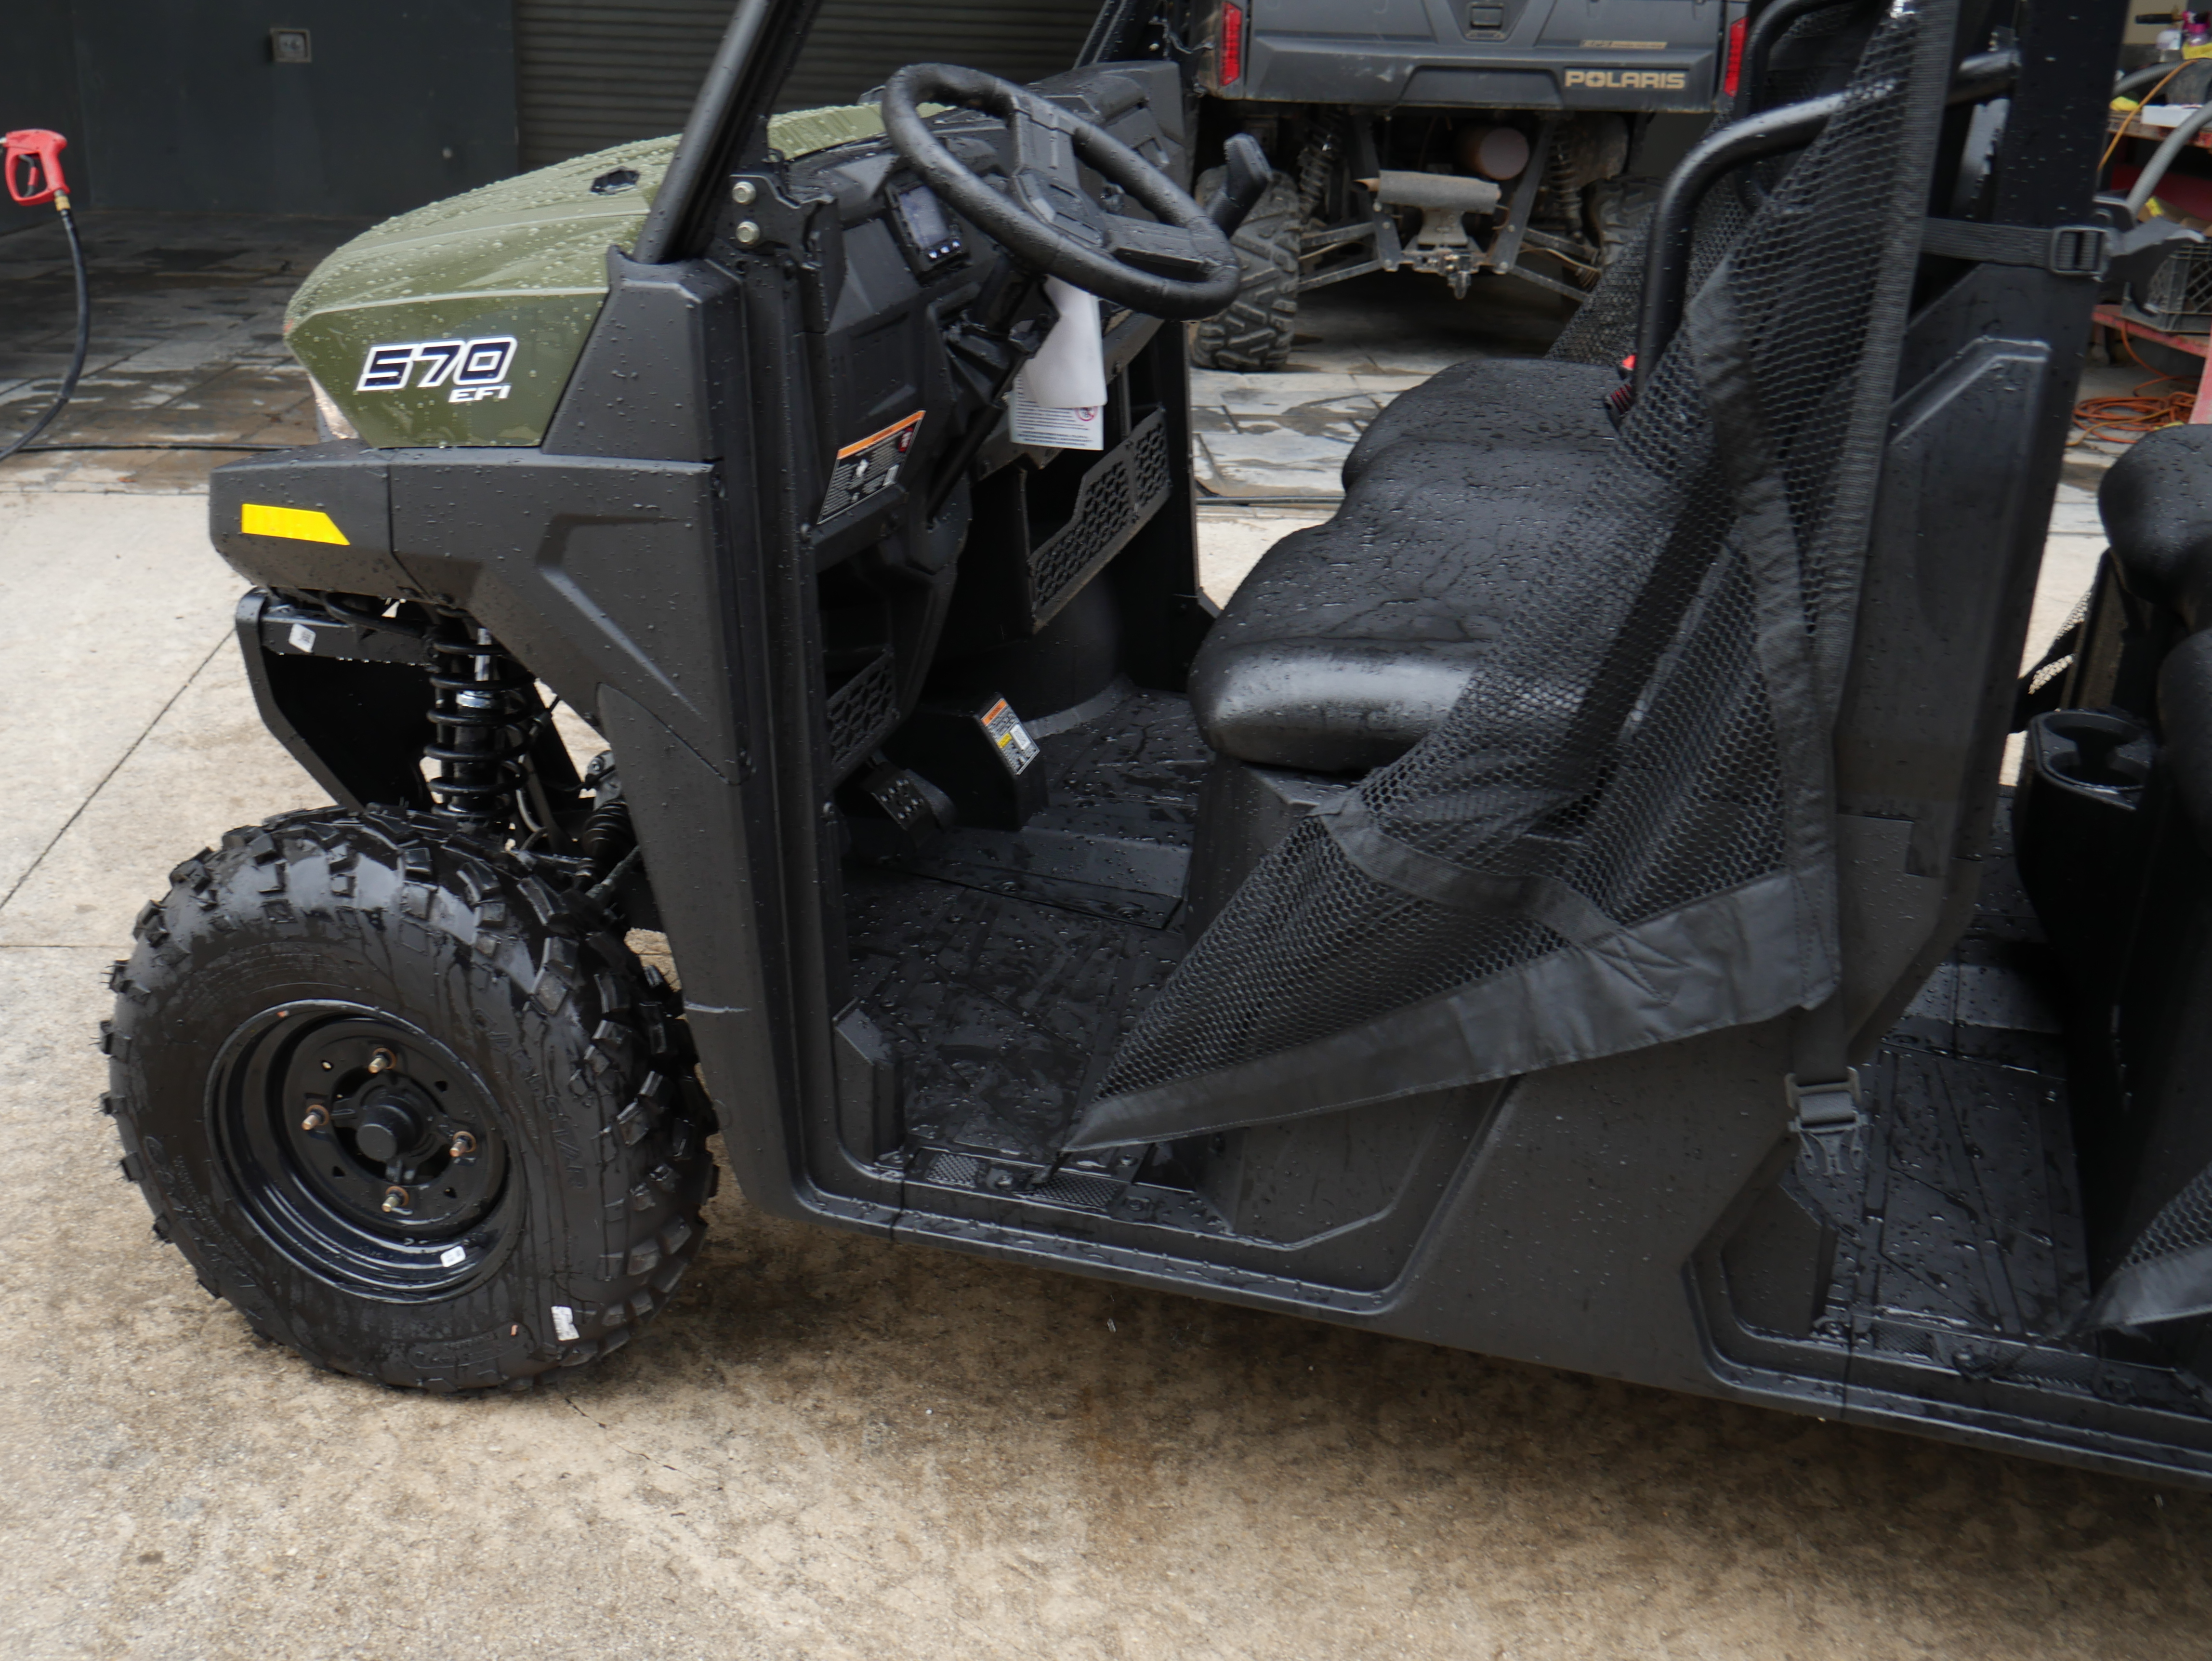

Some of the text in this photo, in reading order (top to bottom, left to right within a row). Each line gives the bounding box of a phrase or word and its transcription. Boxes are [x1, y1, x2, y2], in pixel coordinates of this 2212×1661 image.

[1565, 71, 1685, 89] POLARIS
[356, 336, 517, 391] 570
[448, 385, 512, 403] EFI
